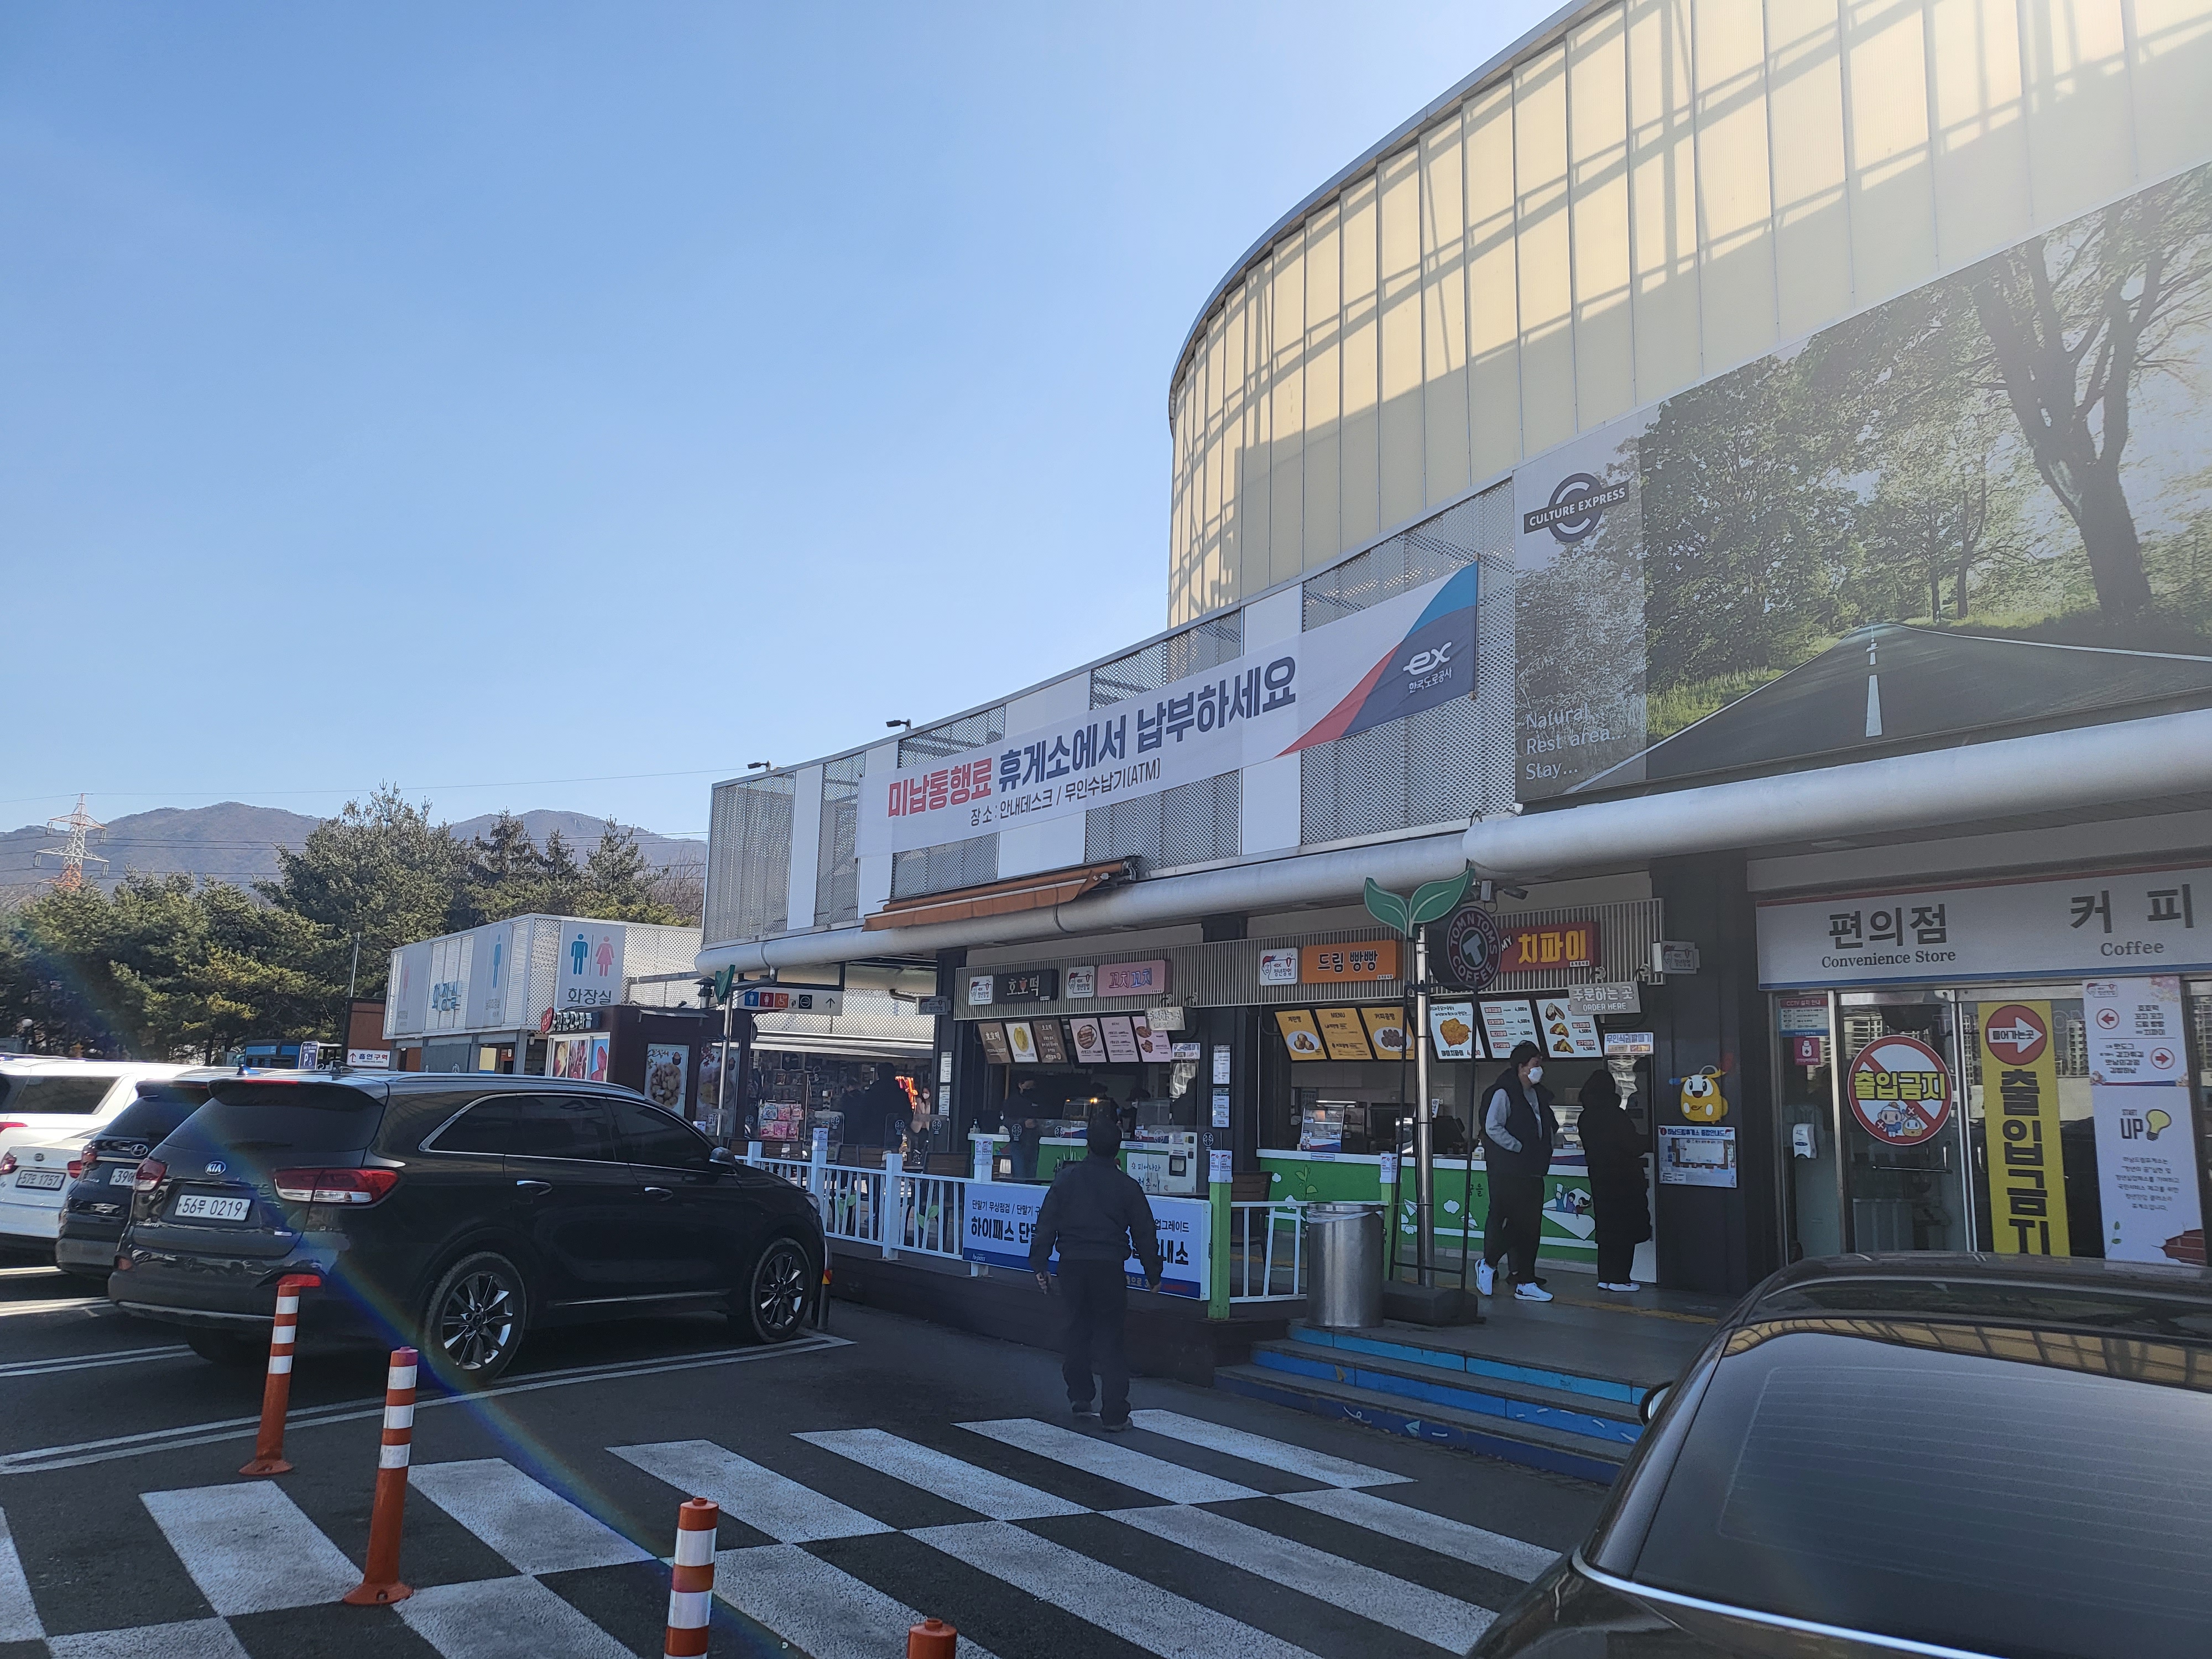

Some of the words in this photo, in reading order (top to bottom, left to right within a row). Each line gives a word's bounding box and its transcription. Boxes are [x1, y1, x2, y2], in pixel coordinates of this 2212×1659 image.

[1529, 504, 1576, 527] CULTURE
[1578, 488, 1626, 512] EXPRESS
[1403, 641, 1452, 675] ex
[1409, 667, 1452, 693] 한국도로공사
[888, 757, 993, 818] 미납통행료
[999, 719, 1127, 793] 휴게소에서
[1137, 655, 1297, 752] 납부하세요
[1526, 737, 1562, 755] Rest
[1000, 789, 1053, 819] 안내데스크
[1065, 758, 1161, 800] 무인수납기(ATM)
[1828, 902, 1948, 950] 편의점
[1518, 929, 1586, 964] 치파이
[2101, 940, 2165, 957] Coffee
[1317, 952, 1344, 973] 드림
[1349, 950, 1379, 972] 빵빵
[1452, 954, 1494, 983] COFFEE
[1821, 952, 1911, 968] Convenience
[1914, 949, 1957, 964] Store
[1274, 968, 1292, 977] 청년창업
[567, 988, 612, 1005] 화장실
[1006, 975, 1040, 996] 호호떡
[1573, 987, 1619, 1002] 주문하는
[1621, 985, 1634, 1000] 곳
[1583, 1003, 1606, 1012] ORDER
[1608, 1002, 1627, 1011] HERE
[1992, 1029, 2034, 1041] 들어가는곳
[1854, 1070, 1947, 1102] 출입금지
[2120, 1118, 2144, 1140] UP
[206, 1161, 222, 1173] KIA
[2000, 1068, 2048, 1256] 출입금지
[210, 1199, 243, 1217] 0219
[972, 1199, 988, 1211] 단말기
[989, 1201, 1010, 1214] 무상점검
[1016, 1204, 1033, 1216] 단말기
[971, 1215, 1014, 1242] 하이패스
